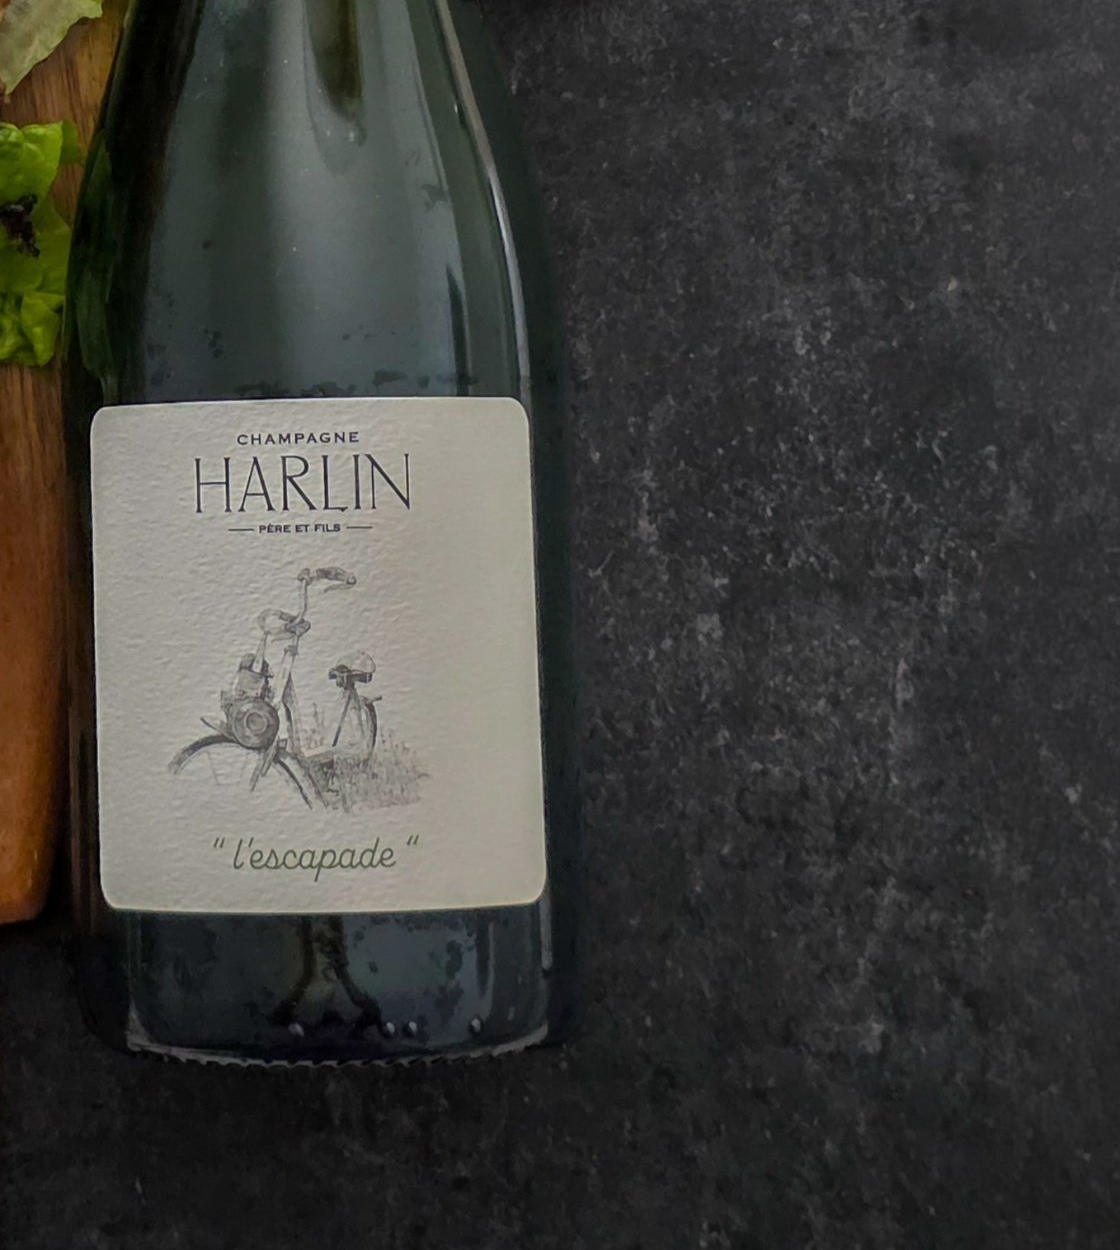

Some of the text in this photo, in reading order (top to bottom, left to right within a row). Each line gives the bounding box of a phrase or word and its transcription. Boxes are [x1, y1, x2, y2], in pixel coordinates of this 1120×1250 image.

[237, 431, 360, 446] CHAMPAGNE
[195, 453, 411, 513] HARLIN
[295, 523, 310, 533] ET
[314, 523, 341, 533] FILS
